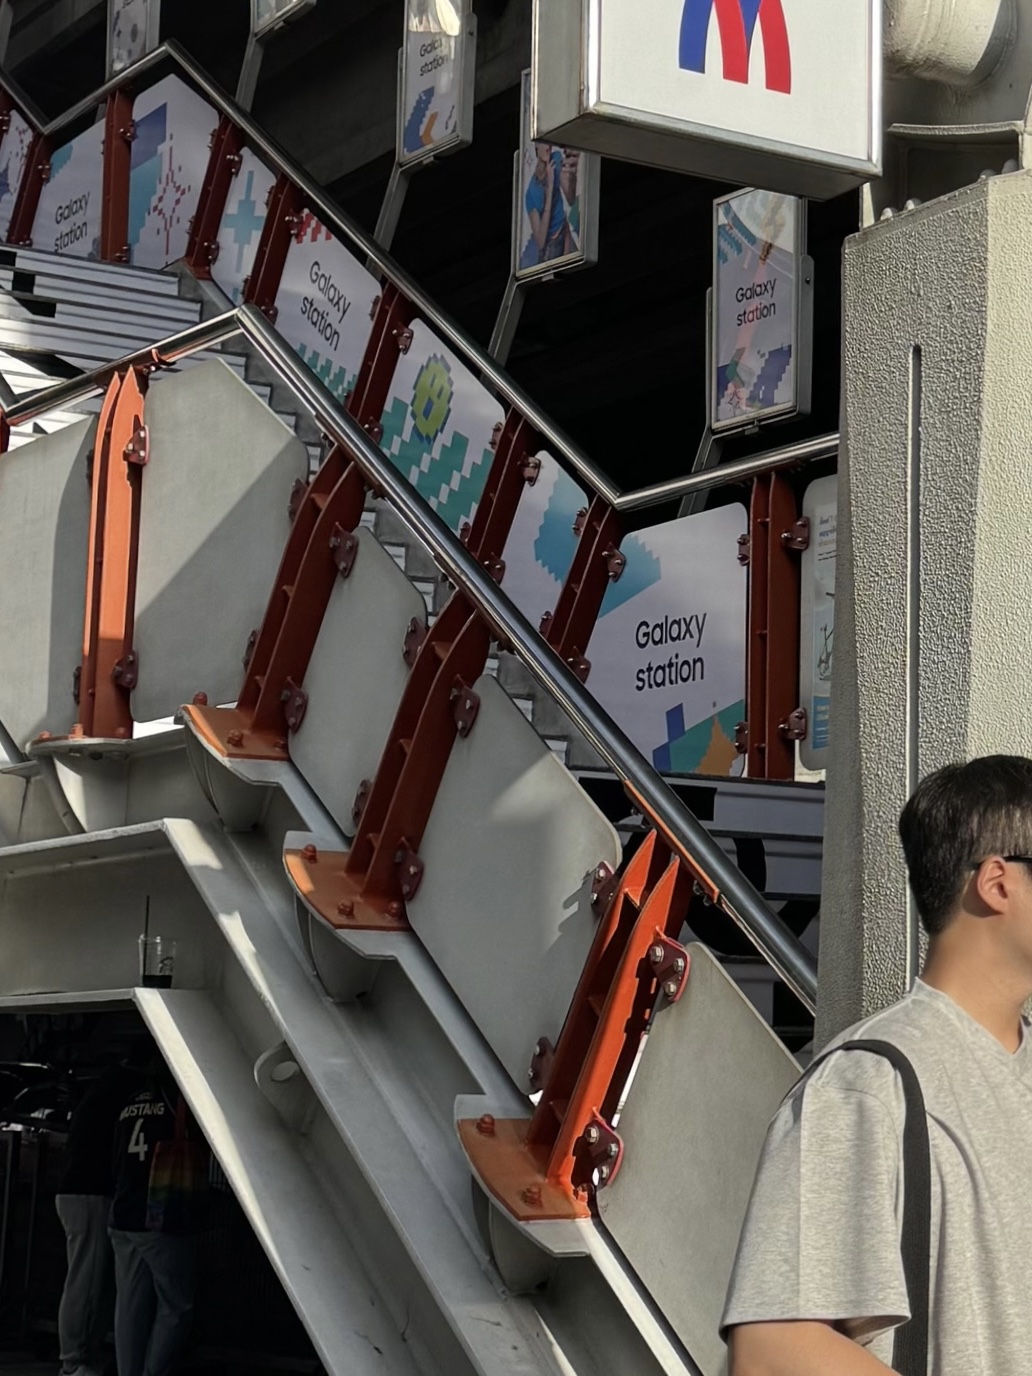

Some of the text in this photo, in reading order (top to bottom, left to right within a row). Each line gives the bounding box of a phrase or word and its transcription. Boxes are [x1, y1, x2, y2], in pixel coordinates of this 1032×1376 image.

[55, 191, 90, 225] Galaxy
[54, 221, 88, 253] station
[310, 260, 352, 324] Galaxy
[735, 278, 777, 303] Galaxy
[300, 296, 340, 351] station
[736, 301, 776, 327] station
[635, 612, 707, 649] Galaxy
[635, 653, 705, 692] station
[127, 1118, 149, 1162] 4
